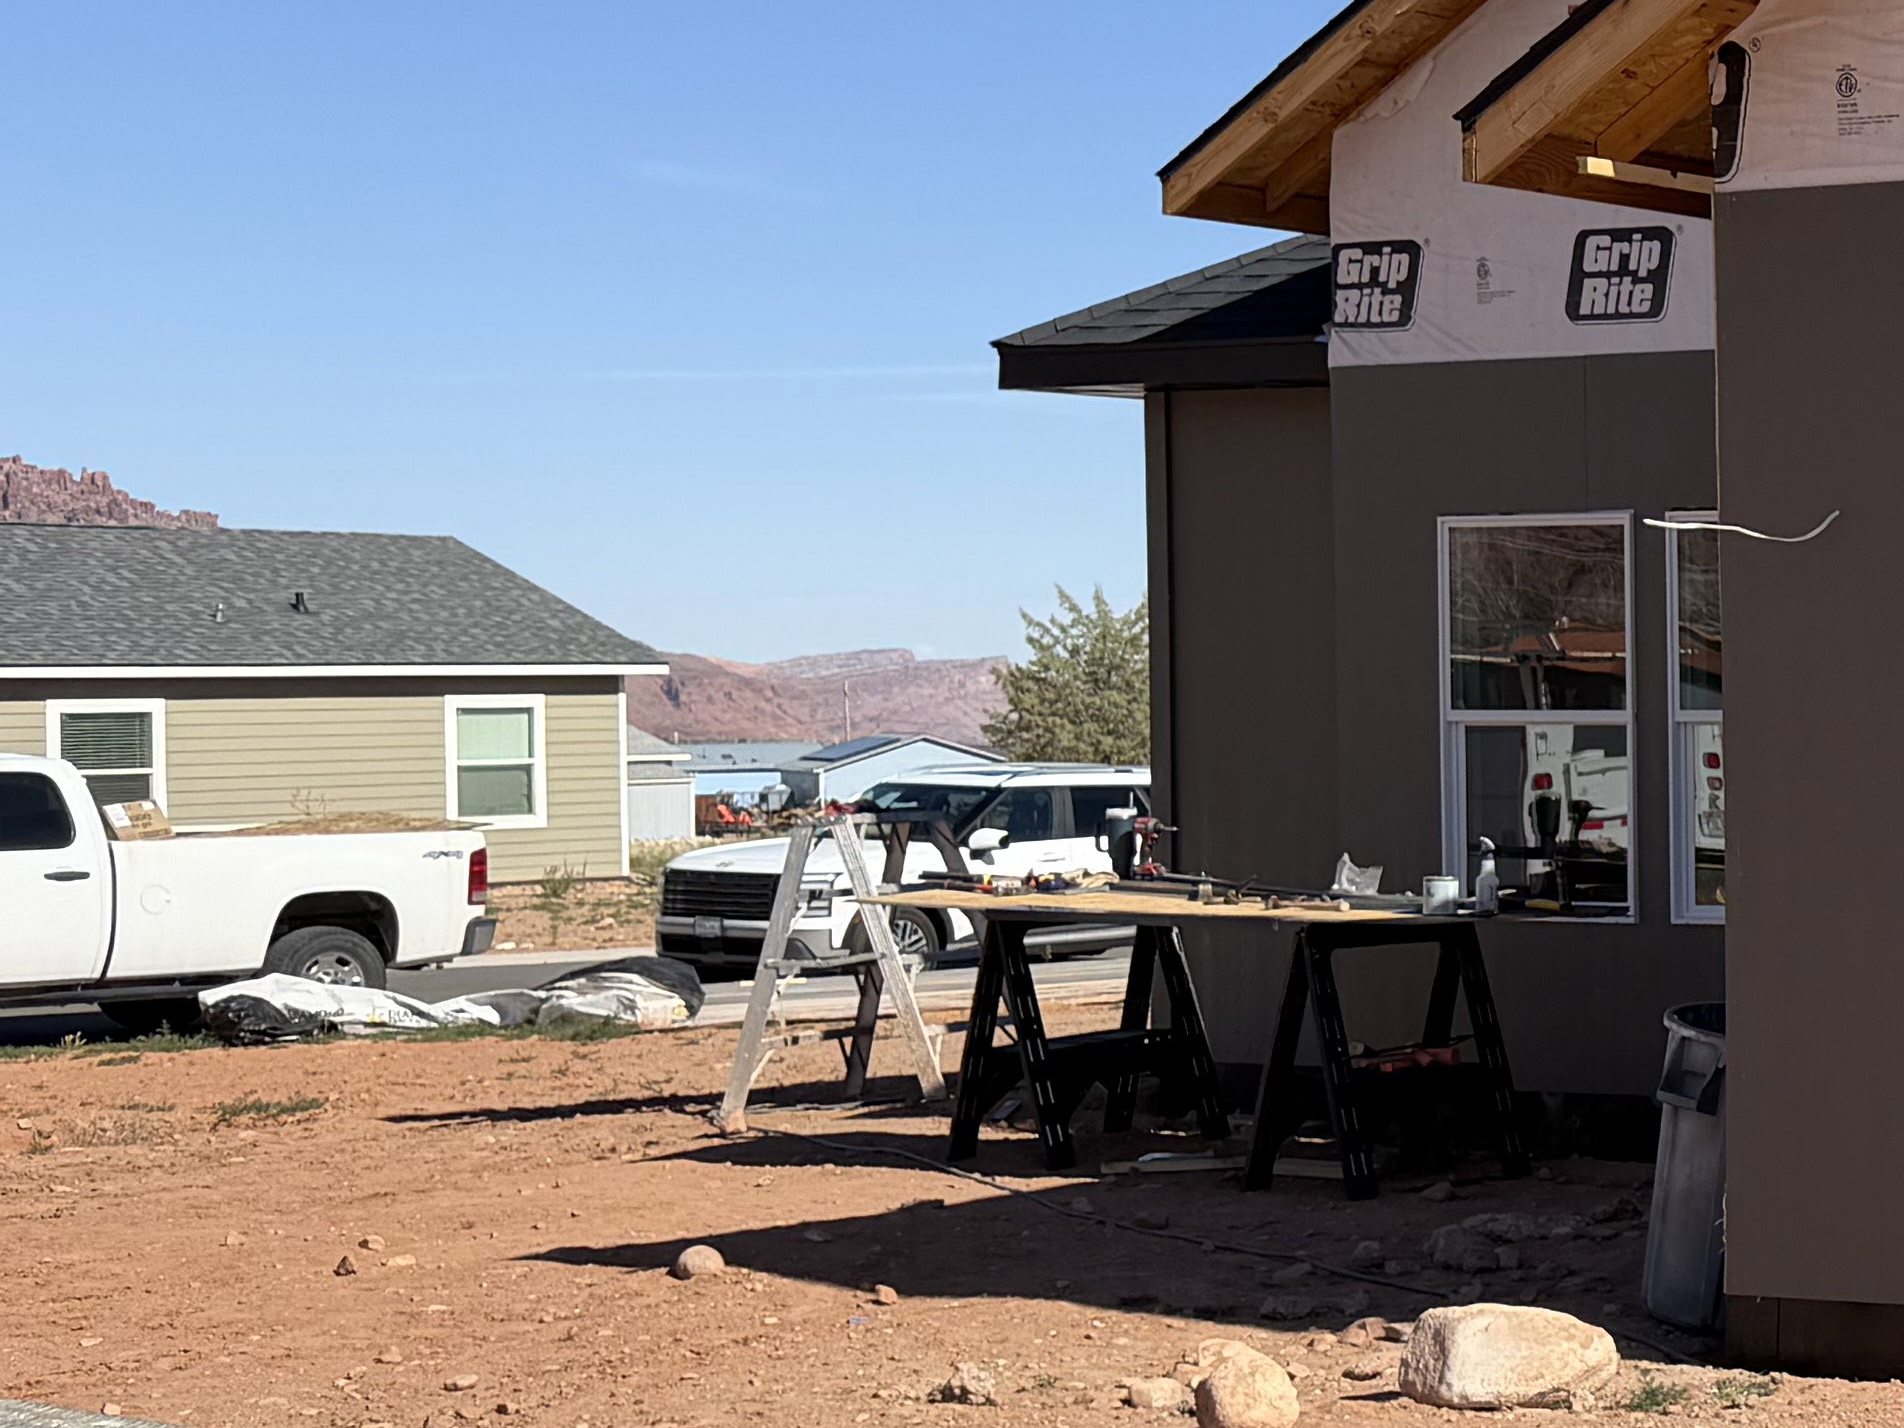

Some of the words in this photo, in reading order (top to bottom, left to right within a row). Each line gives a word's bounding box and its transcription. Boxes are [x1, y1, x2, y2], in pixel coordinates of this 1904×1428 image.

[1336, 246, 1410, 289] Grip
[1582, 233, 1662, 278] Grip
[1333, 287, 1403, 324] Rite
[1578, 276, 1654, 316] Rite
